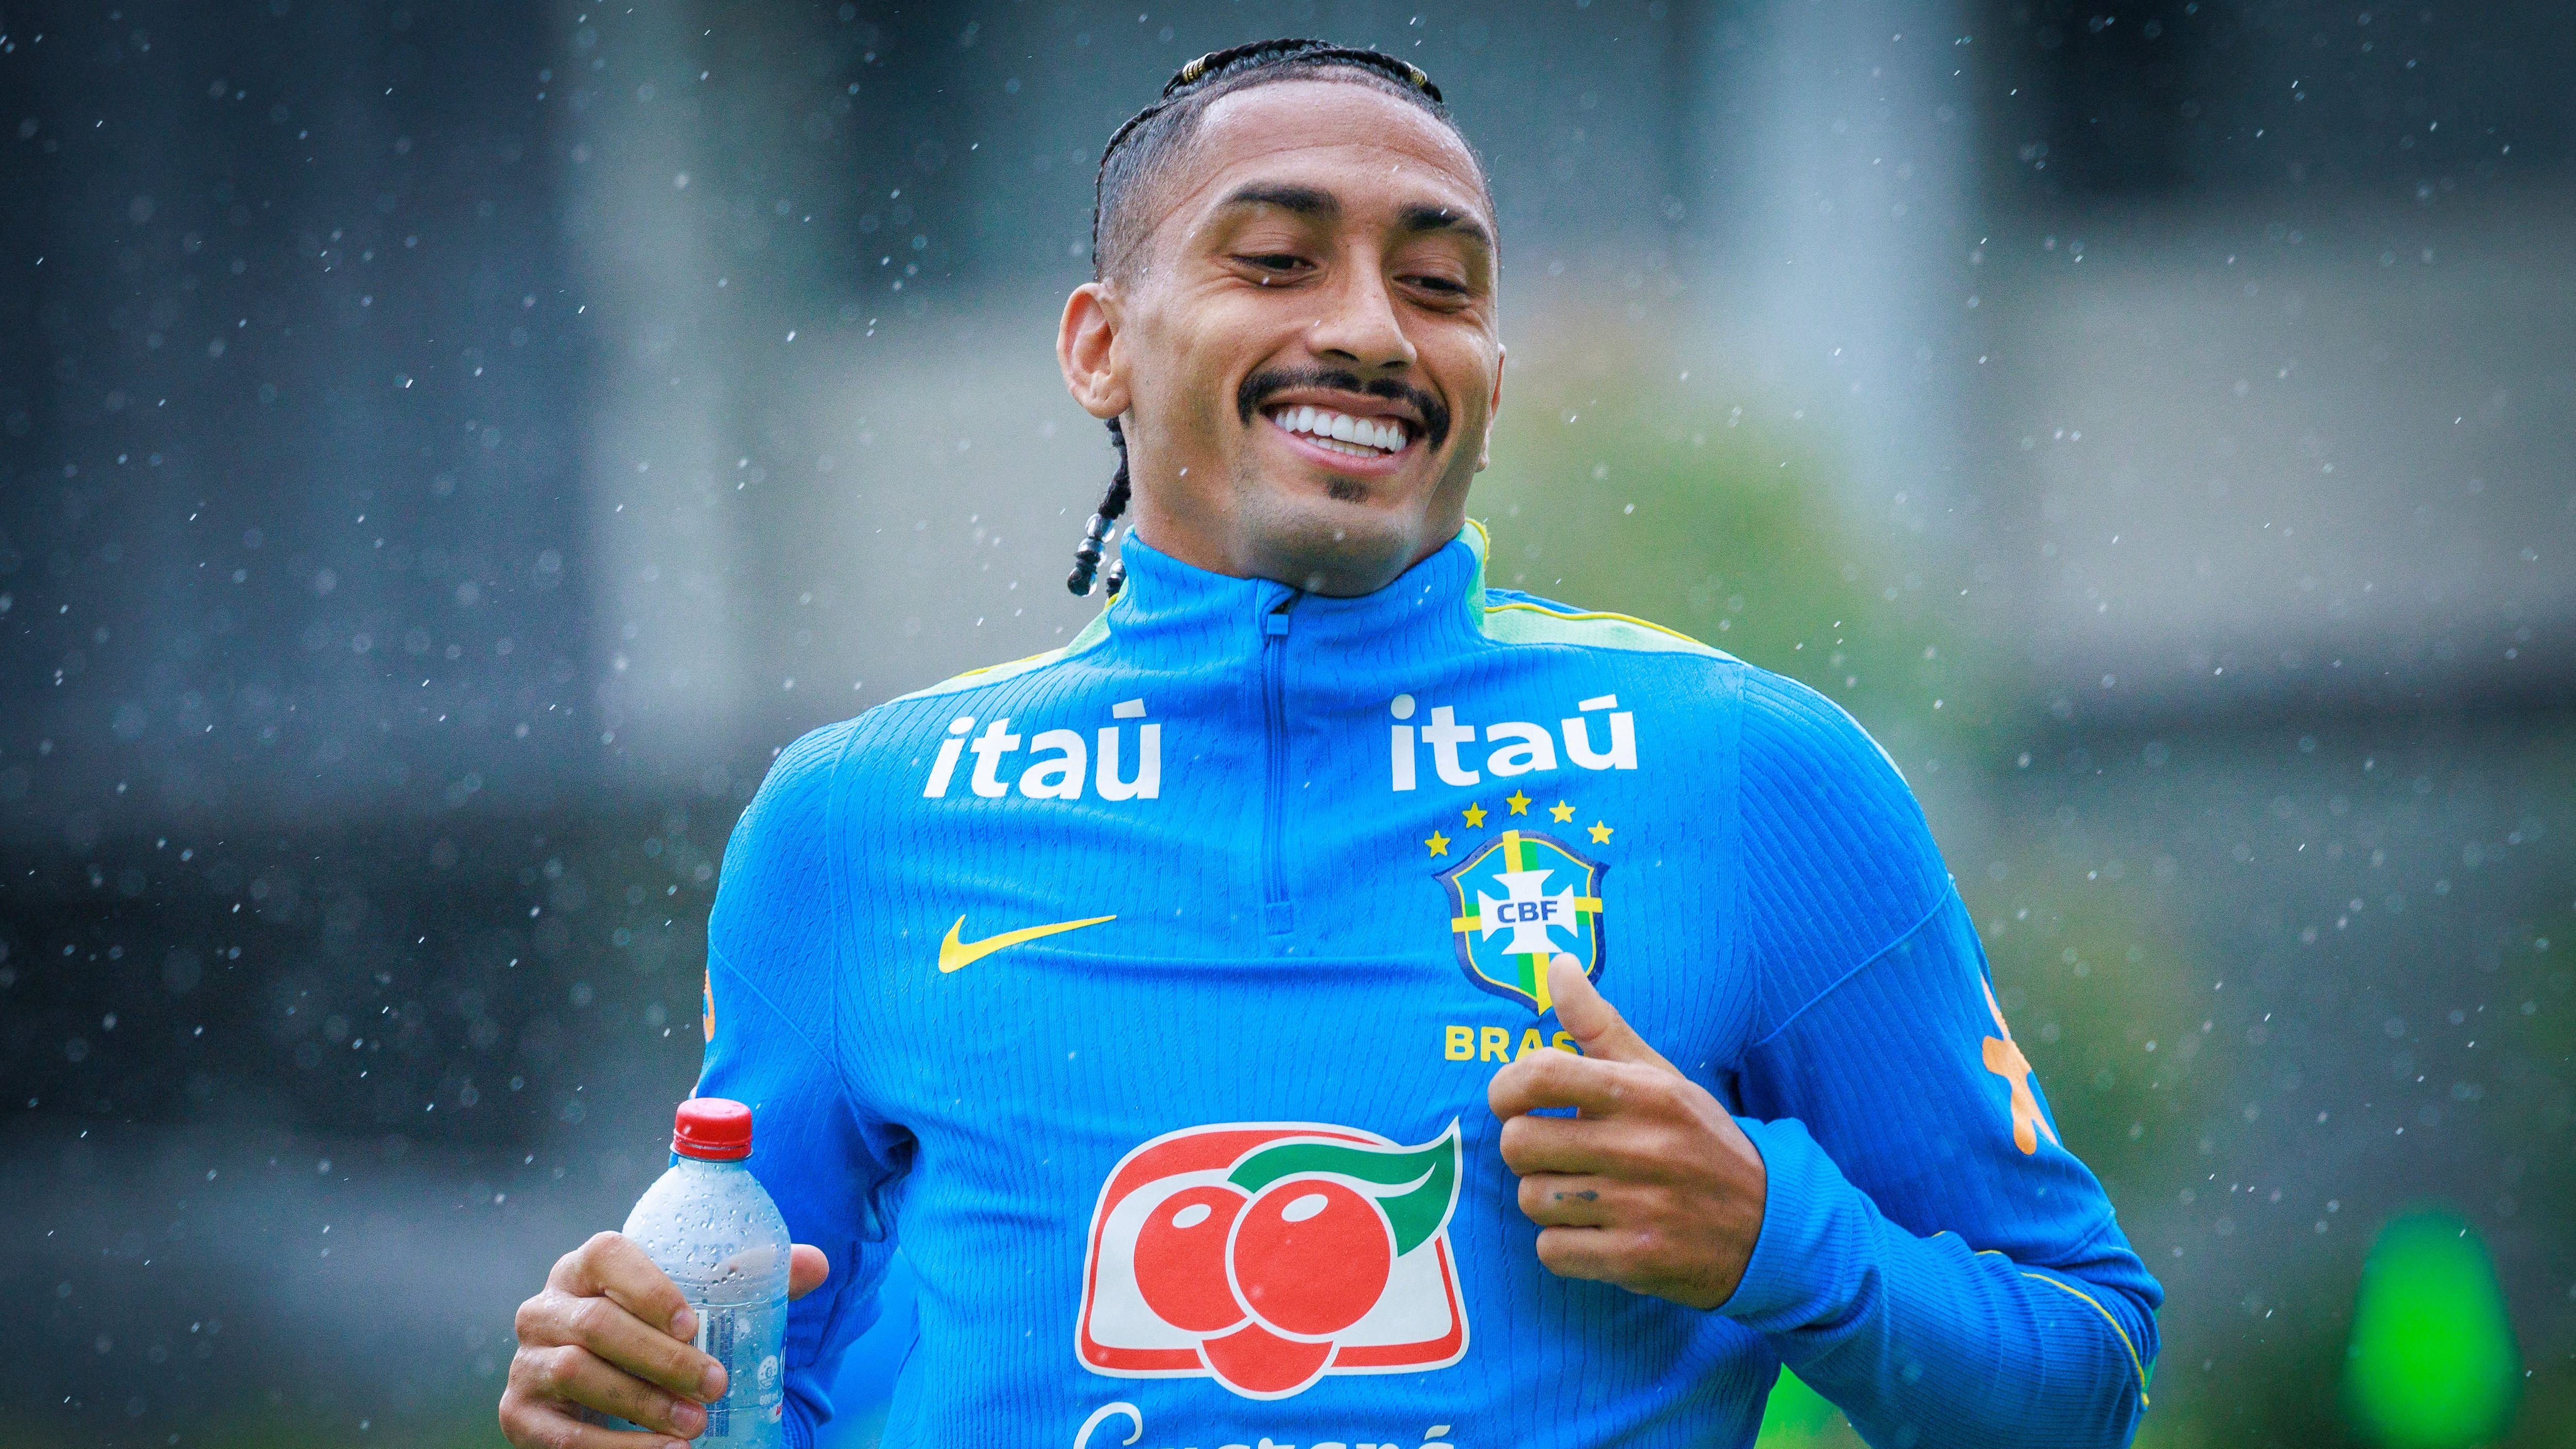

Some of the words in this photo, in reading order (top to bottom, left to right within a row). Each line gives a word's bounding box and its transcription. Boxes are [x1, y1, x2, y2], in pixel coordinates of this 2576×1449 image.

[923, 698, 1161, 801] itaú
[1391, 694, 1638, 792] itaú
[1497, 900, 1558, 923] CBF
[1445, 1025, 1582, 1063] BRAS
